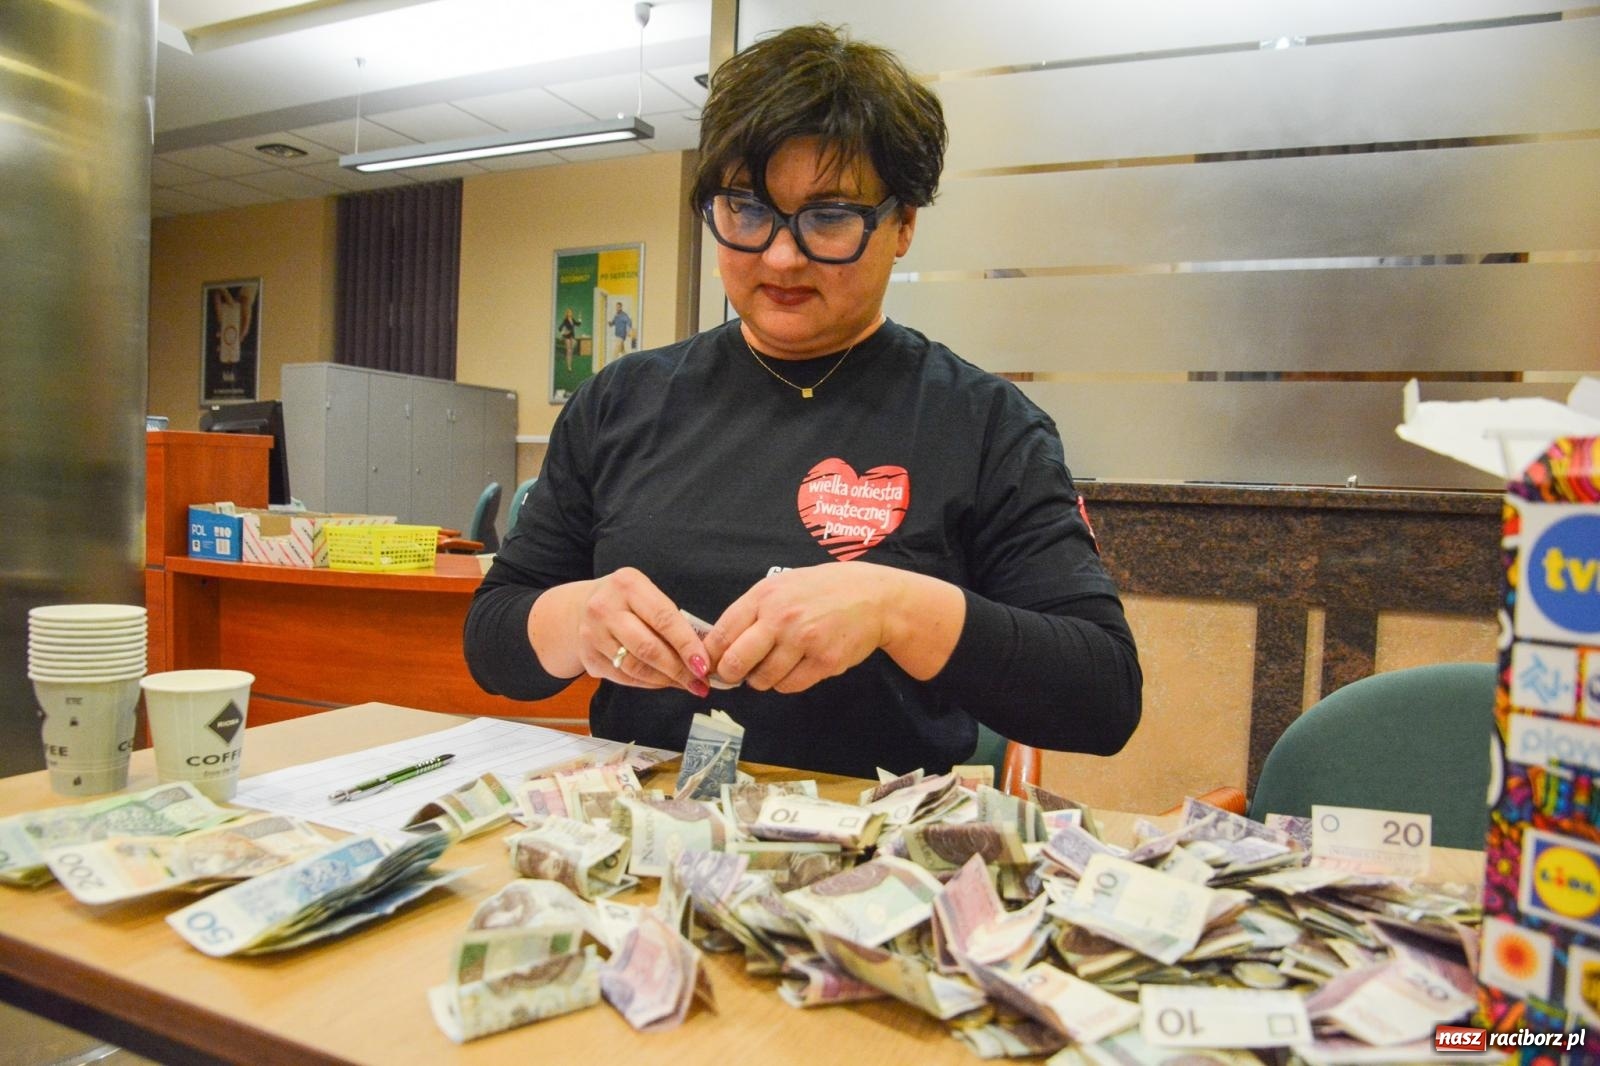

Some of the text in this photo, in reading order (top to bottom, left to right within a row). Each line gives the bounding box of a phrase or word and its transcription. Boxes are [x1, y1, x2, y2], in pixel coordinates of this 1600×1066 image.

[809, 474, 903, 501] wielka orkiestra
[823, 521, 876, 545] pomocy
[1542, 546, 1600, 593] tv
[770, 808, 800, 824] 10
[1383, 820, 1424, 847] 20
[58, 852, 104, 890] 200
[1093, 872, 1118, 897] 10
[186, 911, 234, 945] 50
[1157, 1008, 1204, 1036] 10
